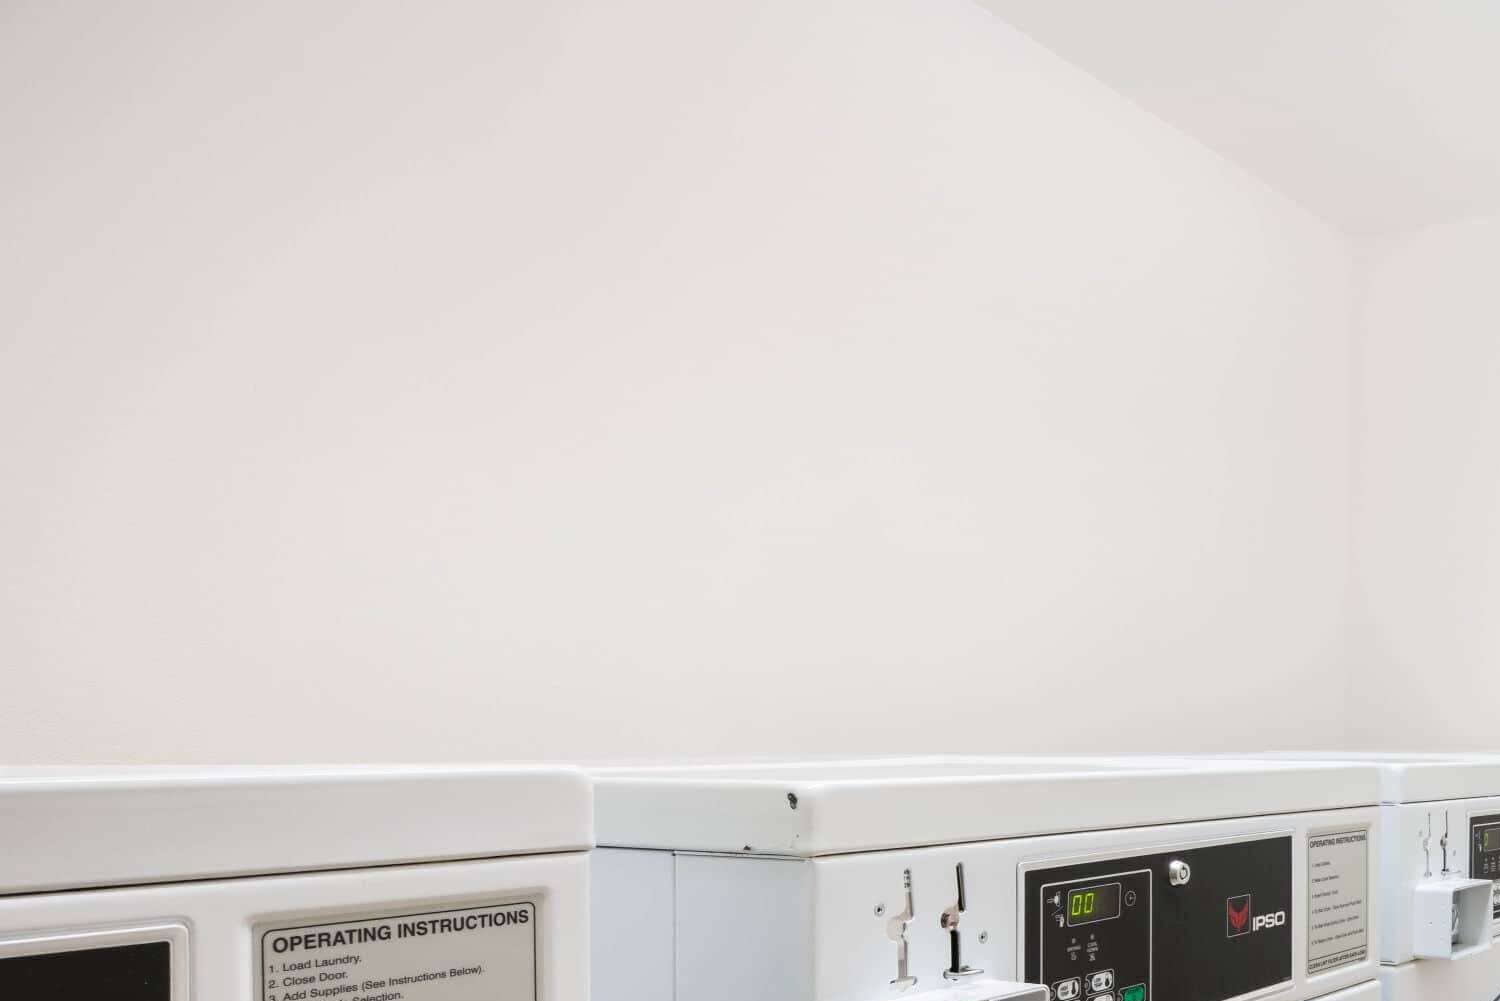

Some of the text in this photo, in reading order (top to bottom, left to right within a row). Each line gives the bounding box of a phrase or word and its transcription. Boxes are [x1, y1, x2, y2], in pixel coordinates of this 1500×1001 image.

[1072, 893, 1094, 916] 00
[272, 909, 529, 953] OPERATING INSTRUCTIONS
[1253, 911, 1285, 931] IPSO
[269, 955, 361, 973] 1. Load Laundry.
[283, 975, 315, 987] Close
[319, 971, 348, 982] Door.
[283, 990, 306, 1001] Add
[310, 983, 358, 998] Supplies
[362, 980, 386, 992] (See
[389, 970, 446, 986] Instructions
